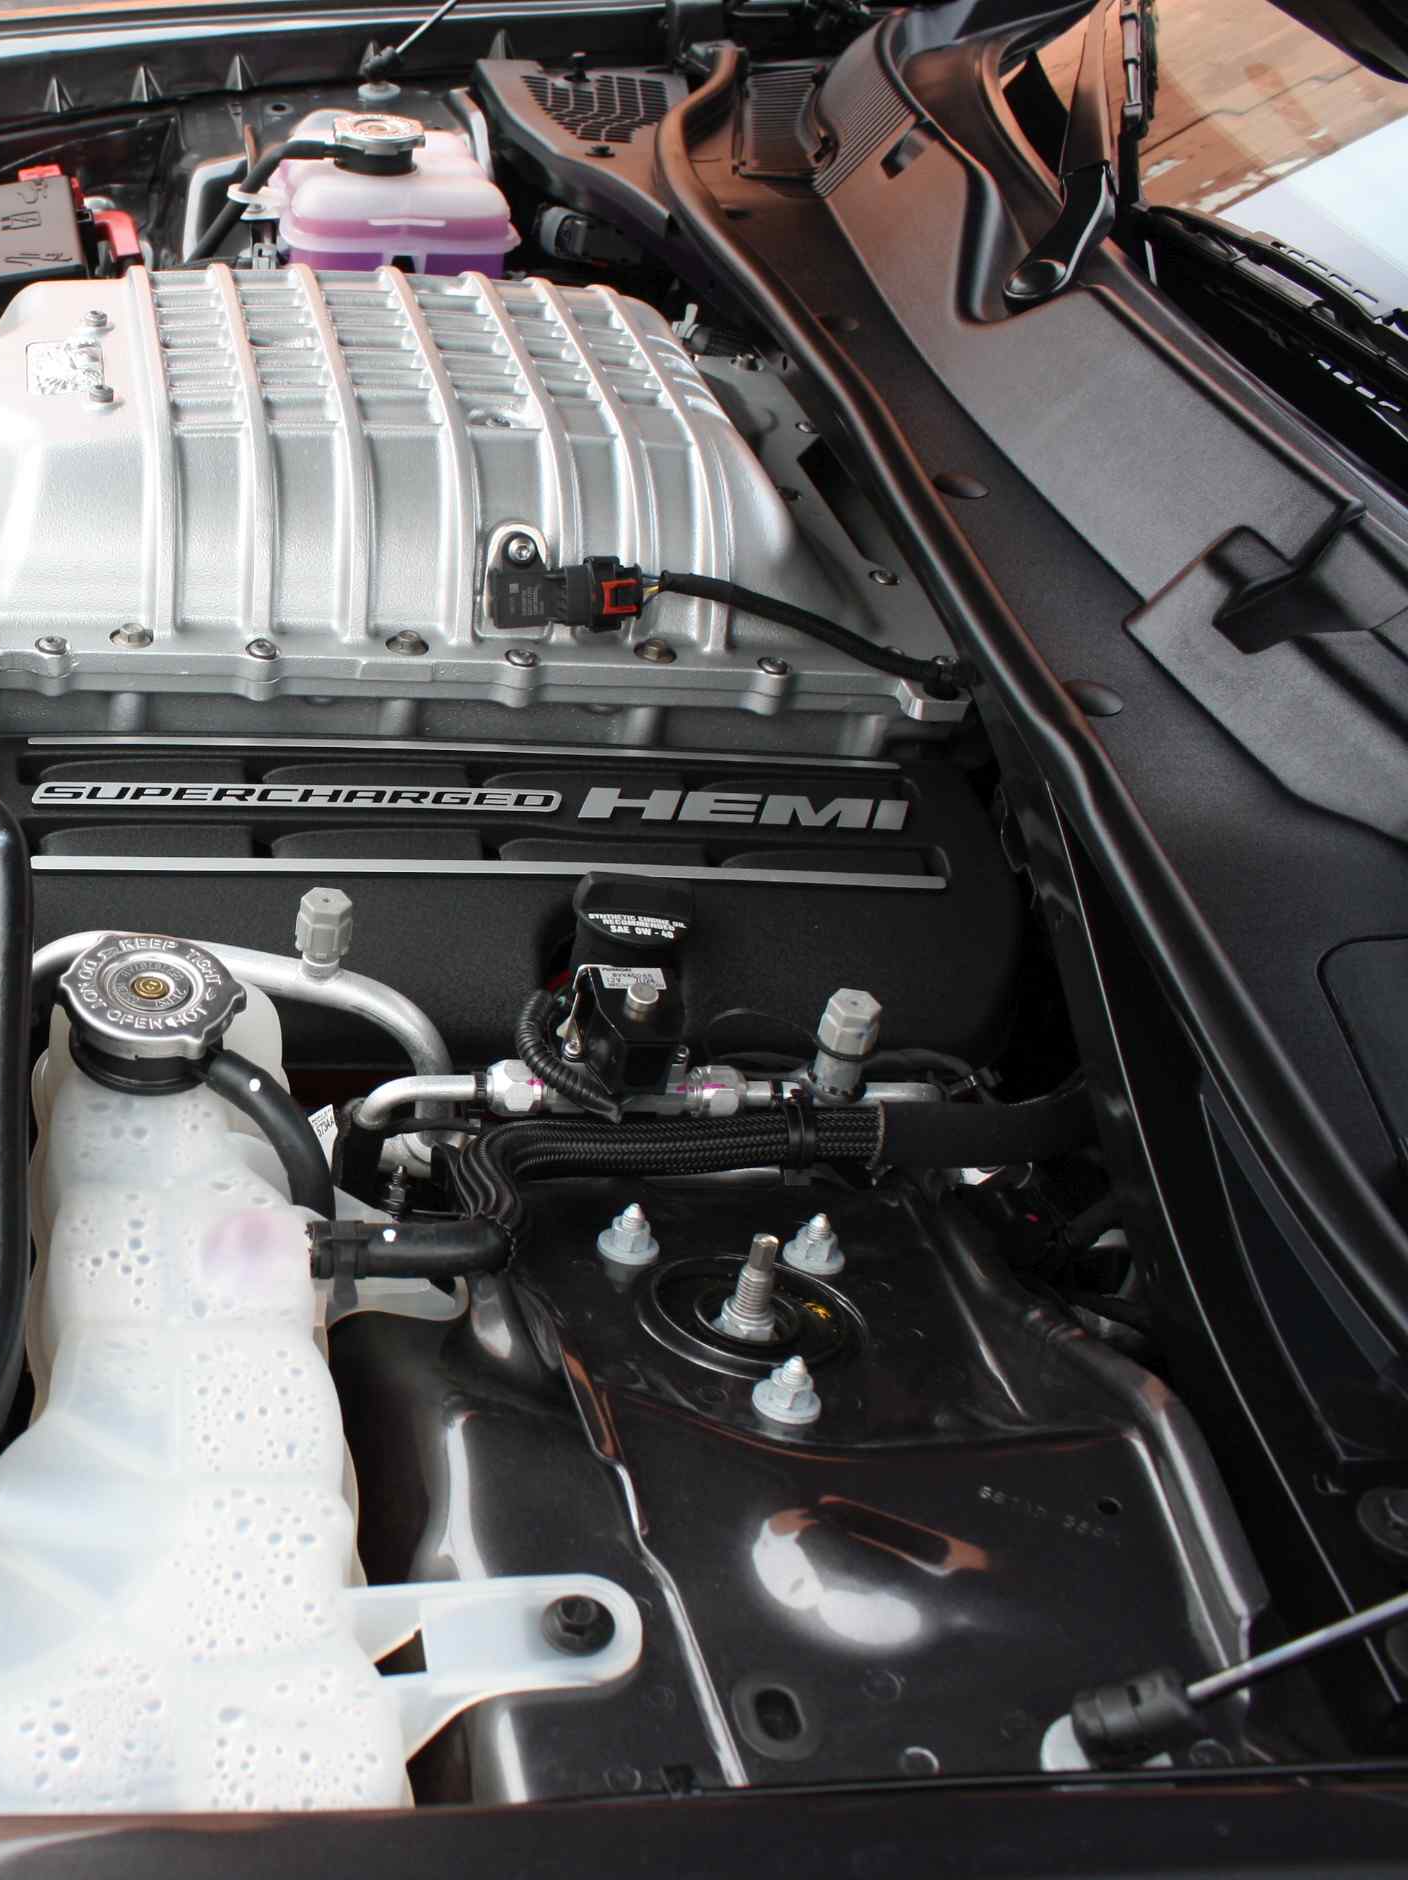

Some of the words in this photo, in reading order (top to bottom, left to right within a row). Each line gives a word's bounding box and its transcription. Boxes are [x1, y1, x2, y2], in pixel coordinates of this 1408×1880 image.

[37, 784, 556, 808] SUPERCHARGED
[577, 786, 910, 831] HEMI
[610, 925, 631, 934] SAE
[118, 937, 177, 952] KEEP
[107, 1009, 163, 1030] OPEN
